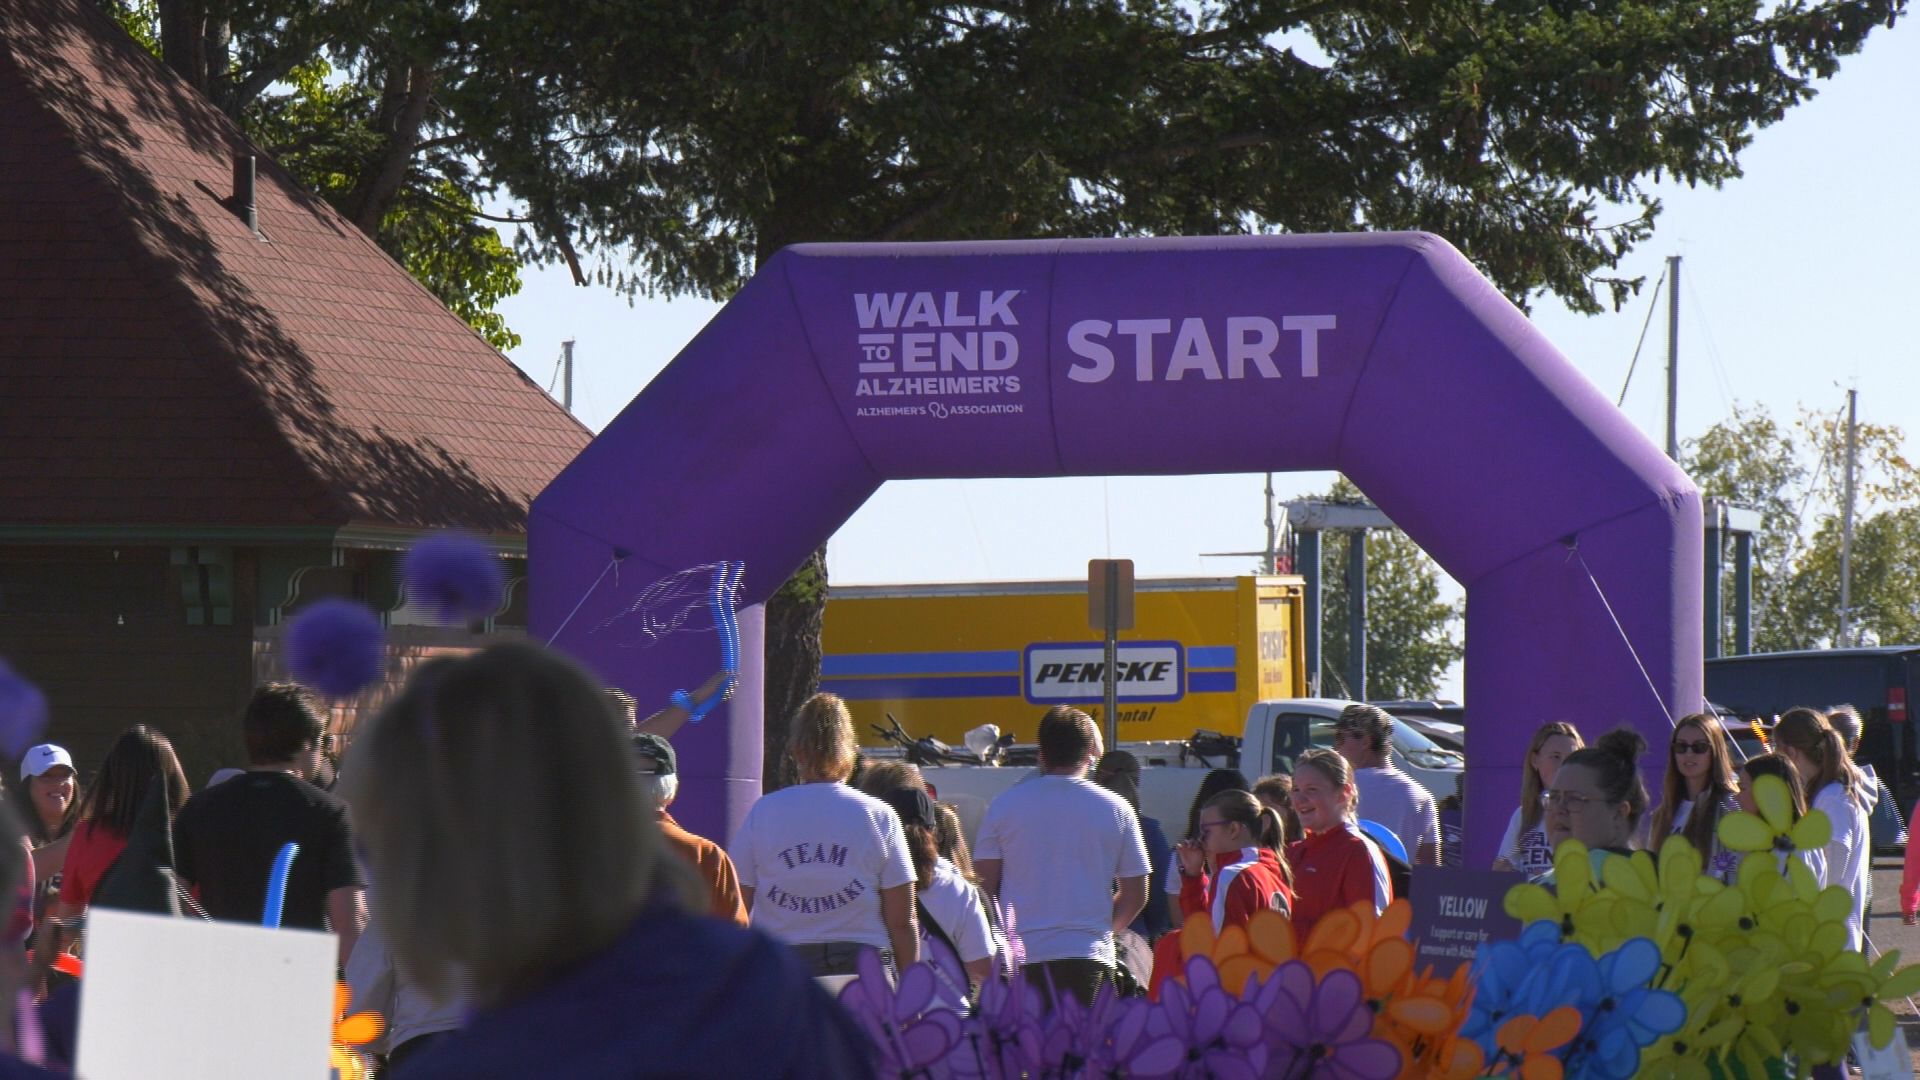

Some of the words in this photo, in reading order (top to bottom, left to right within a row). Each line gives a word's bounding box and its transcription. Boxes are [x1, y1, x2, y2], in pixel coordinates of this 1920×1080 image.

[854, 289, 1021, 329] WALK
[861, 345, 891, 361] TO
[902, 331, 1019, 372] END
[1067, 315, 1337, 383] START
[855, 375, 1021, 396] ALZHEIMER'S
[856, 405, 927, 417] ALZHEIMER'S
[950, 403, 1024, 415] ASSOCIATION
[1117, 706, 1156, 723] ental
[777, 842, 849, 870] TEAM
[1439, 895, 1489, 919] YELLOW
[1434, 928, 1457, 942] support
[1457, 931, 1465, 940] or
[1464, 931, 1478, 941] care
[1478, 928, 1490, 941] for
[1420, 944, 1446, 956] someone
[1446, 943, 1459, 957] with
